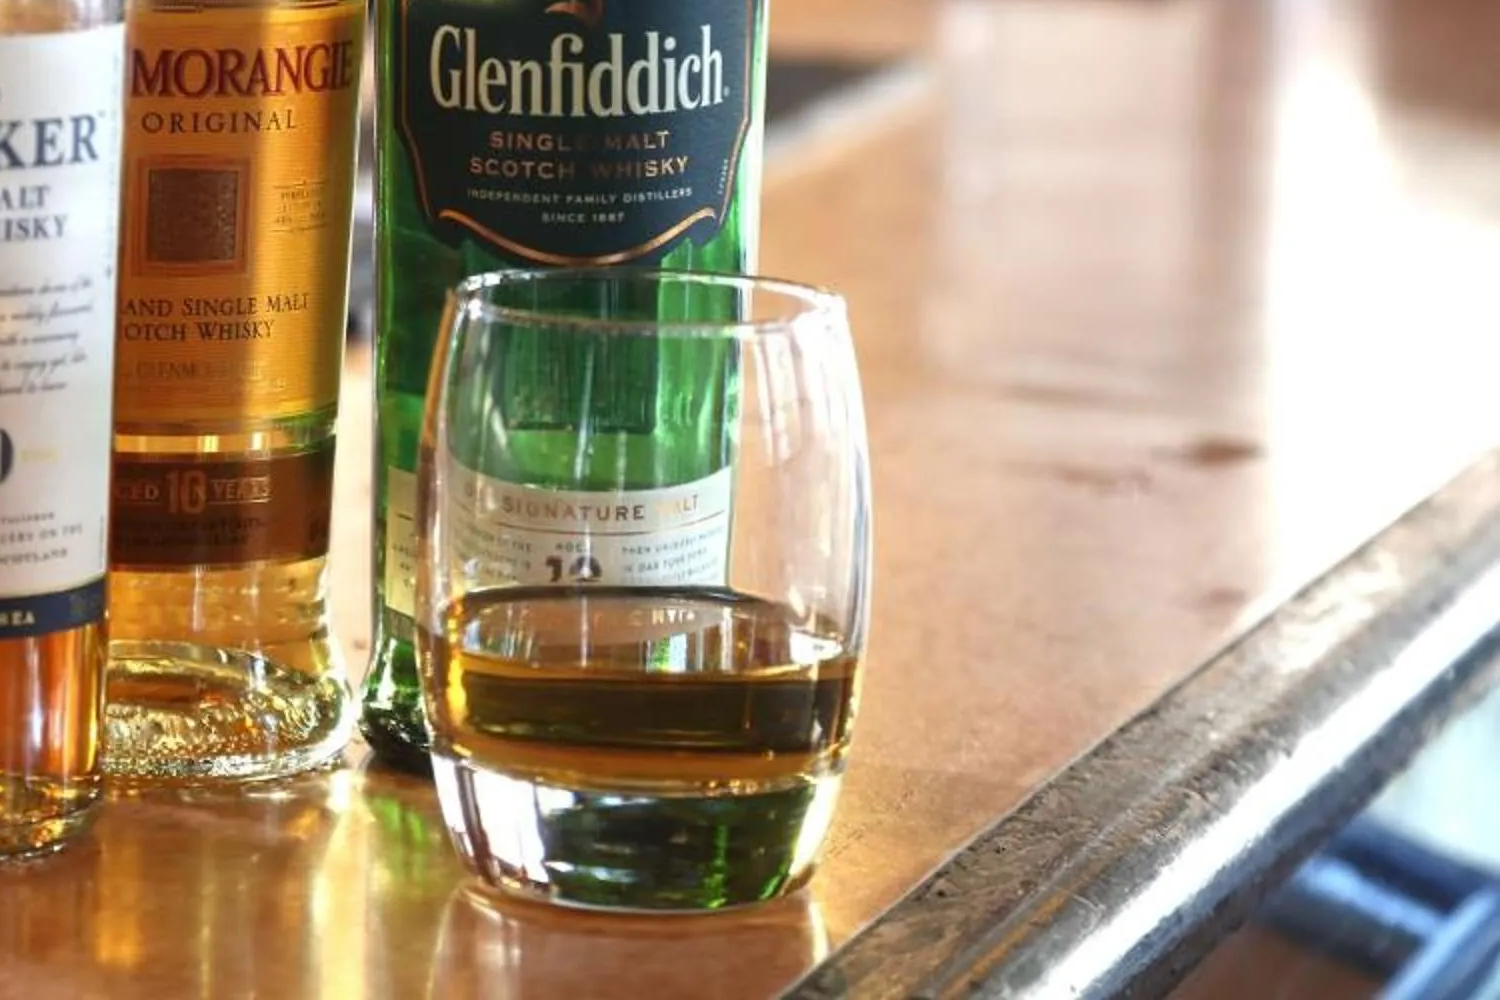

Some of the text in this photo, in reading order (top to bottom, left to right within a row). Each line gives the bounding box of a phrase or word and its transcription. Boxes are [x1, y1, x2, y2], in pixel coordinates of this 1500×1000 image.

[131, 41, 354, 98] MORANGIE
[430, 23, 723, 118] Glenfiddich
[141, 109, 297, 135] ORIGINAL
[605, 129, 670, 150] MALT
[469, 156, 575, 180] SCOTCH
[590, 155, 689, 180] WHISKY
[466, 186, 693, 205] INDEPENDENT FAMILY DISTILLERS
[541, 211, 586, 223] SINCE
[181, 297, 258, 317] SINGLE
[266, 292, 309, 313] MALT
[124, 319, 275, 342] OTCH WHISKY
[166, 470, 207, 514] 10
[501, 494, 645, 522] SIGNATURE
